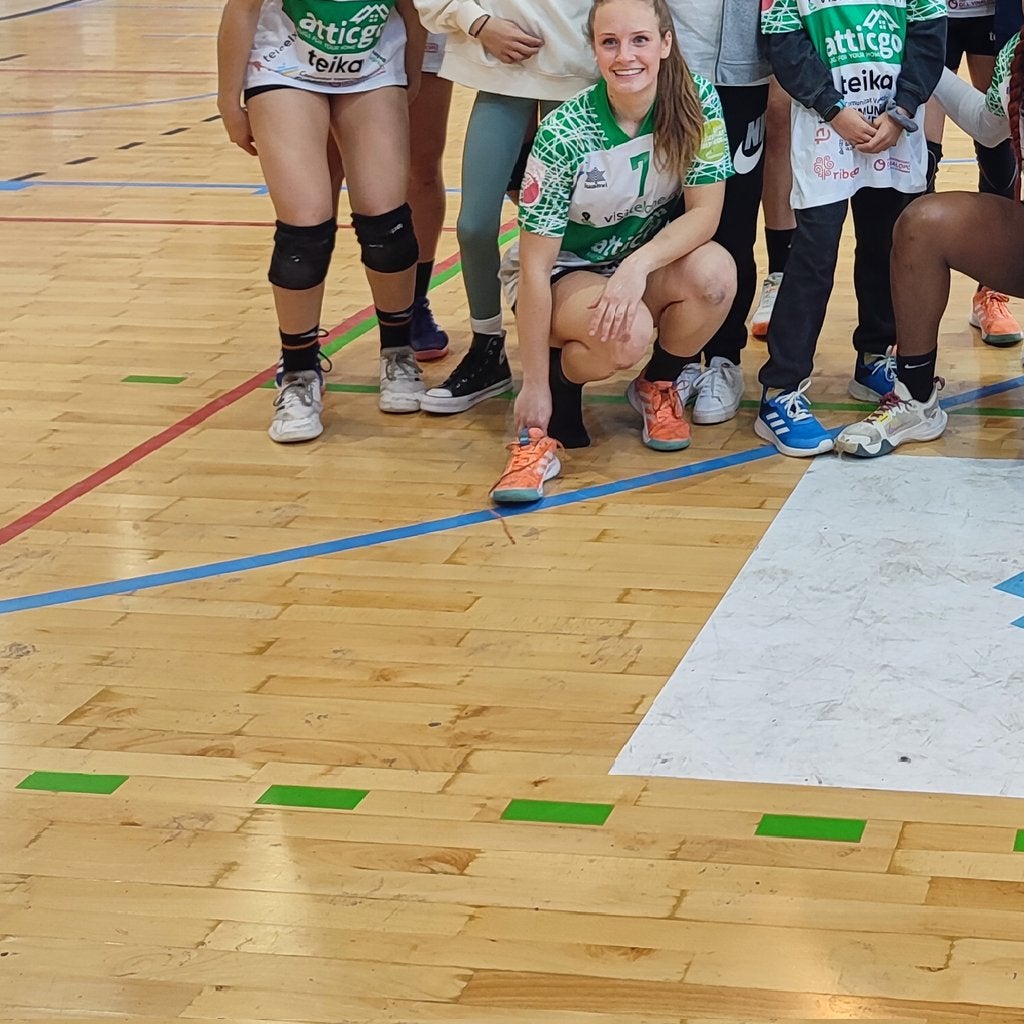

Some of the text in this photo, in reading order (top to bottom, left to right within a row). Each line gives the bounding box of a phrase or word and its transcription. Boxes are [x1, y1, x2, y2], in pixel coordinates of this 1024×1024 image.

[825, 25, 903, 59] atticgo
[308, 49, 365, 74] teika
[840, 69, 893, 95] teika
[629, 150, 651, 197] 7
